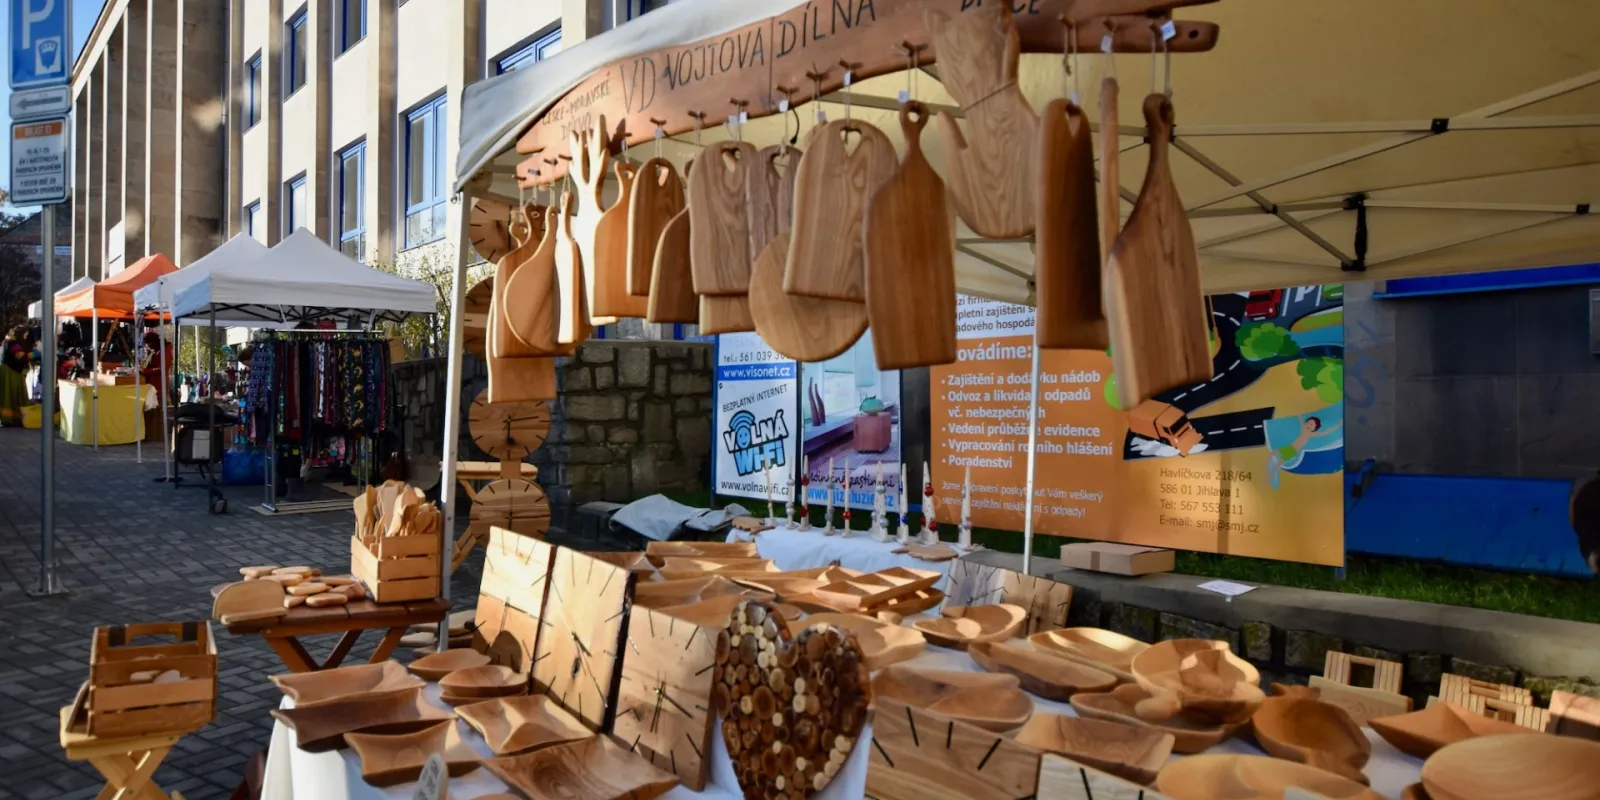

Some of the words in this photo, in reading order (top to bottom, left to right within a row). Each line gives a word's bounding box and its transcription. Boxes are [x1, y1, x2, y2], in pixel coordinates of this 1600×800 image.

[21, 0, 57, 50] P
[619, 56, 657, 115] VD
[665, 27, 765, 91] VOJTOVA
[776, 0, 876, 59] DÍLNA
[957, 307, 984, 320] pletní
[985, 304, 1026, 318] zajištění
[956, 320, 994, 332] adového
[996, 316, 1036, 331] hospodá
[739, 351, 754, 362] 561
[756, 350, 773, 362] 039
[957, 341, 1032, 361] ovádíme:
[722, 365, 792, 378] www.visonet.cz
[947, 372, 994, 388] Zajištění
[997, 375, 1004, 385] a
[1006, 371, 1058, 385] dodáku
[1060, 369, 1101, 384] nádob
[722, 392, 755, 413] BEZPLATNÝ
[756, 383, 788, 401] INTERNET
[947, 390, 982, 402] Odvoz
[983, 392, 991, 401] a
[993, 388, 1042, 401] likvida
[1044, 386, 1091, 404] odpadů
[947, 405, 964, 418] vč.
[965, 404, 1046, 421] nebezpečnýh
[947, 421, 985, 435] Vedení
[1044, 423, 1101, 437] evidence
[947, 438, 1015, 453] Vypracování
[1017, 440, 1064, 454] roního
[1066, 441, 1113, 456] hlášení
[947, 453, 1013, 469] Poradenství
[849, 469, 896, 489] zastínní
[1159, 467, 1212, 480] Havlíčkova
[1214, 469, 1252, 482] 218/64
[941, 480, 961, 491] Jsme
[1047, 487, 1068, 499] Vám
[1069, 489, 1103, 504] veškerý
[1159, 483, 1178, 494] 586
[1180, 484, 1193, 495] 01
[1196, 485, 1231, 498] Jihlava
[1235, 488, 1240, 498] 1
[1050, 505, 1086, 519] odpady!
[1159, 498, 1177, 510] Tel:
[1180, 500, 1199, 511] 567
[1202, 502, 1221, 514] 553
[1224, 503, 1244, 515] 111
[1159, 514, 1193, 527] E-mail:
[1196, 519, 1260, 534] smj@smj.cz
